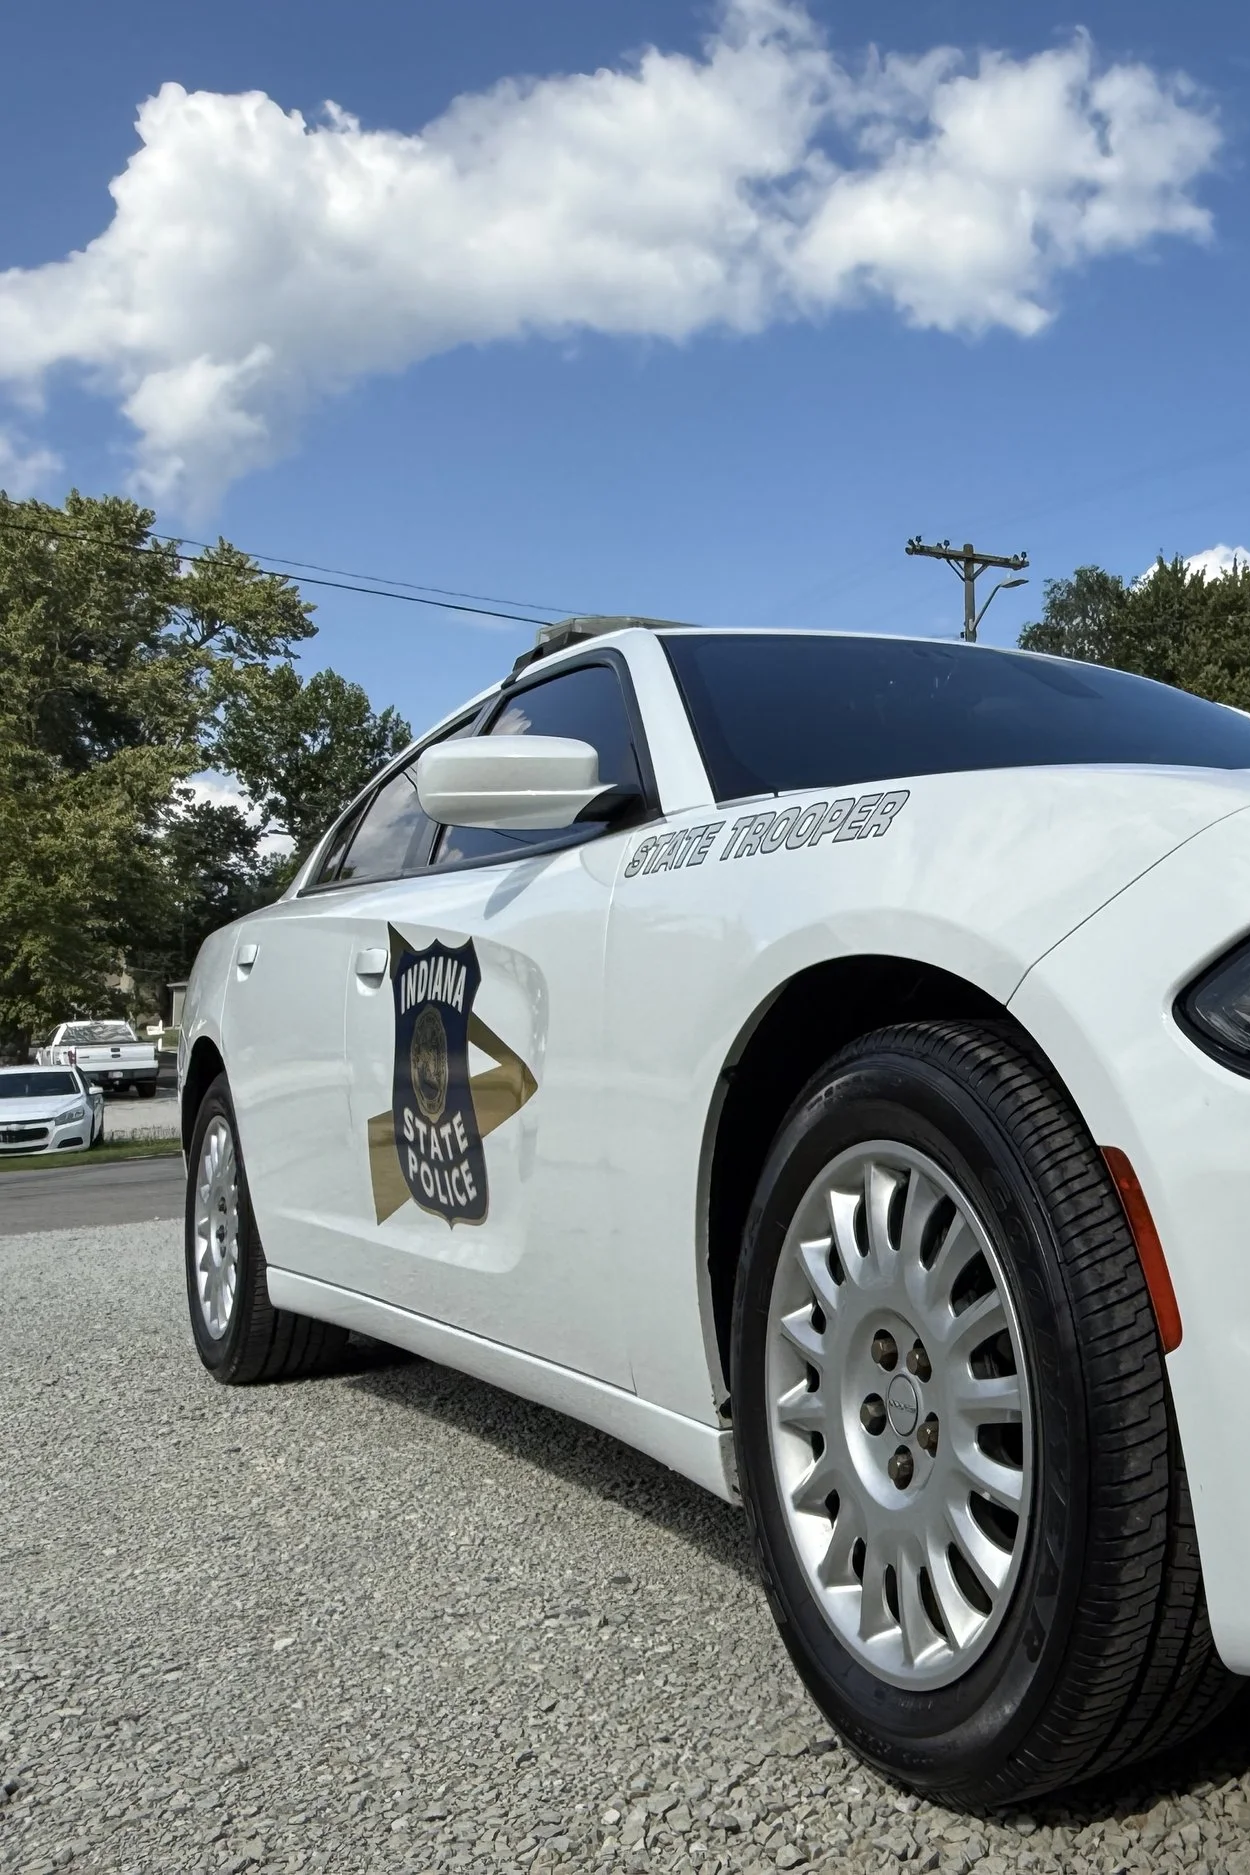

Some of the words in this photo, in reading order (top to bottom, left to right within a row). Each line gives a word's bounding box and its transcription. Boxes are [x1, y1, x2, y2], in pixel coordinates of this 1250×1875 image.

[624, 820, 726, 878] STATE
[719, 789, 911, 861] TROOPER
[401, 955, 467, 1015] INDIANA
[403, 1107, 468, 1162] STATE
[407, 1147, 477, 1207] POLICE
